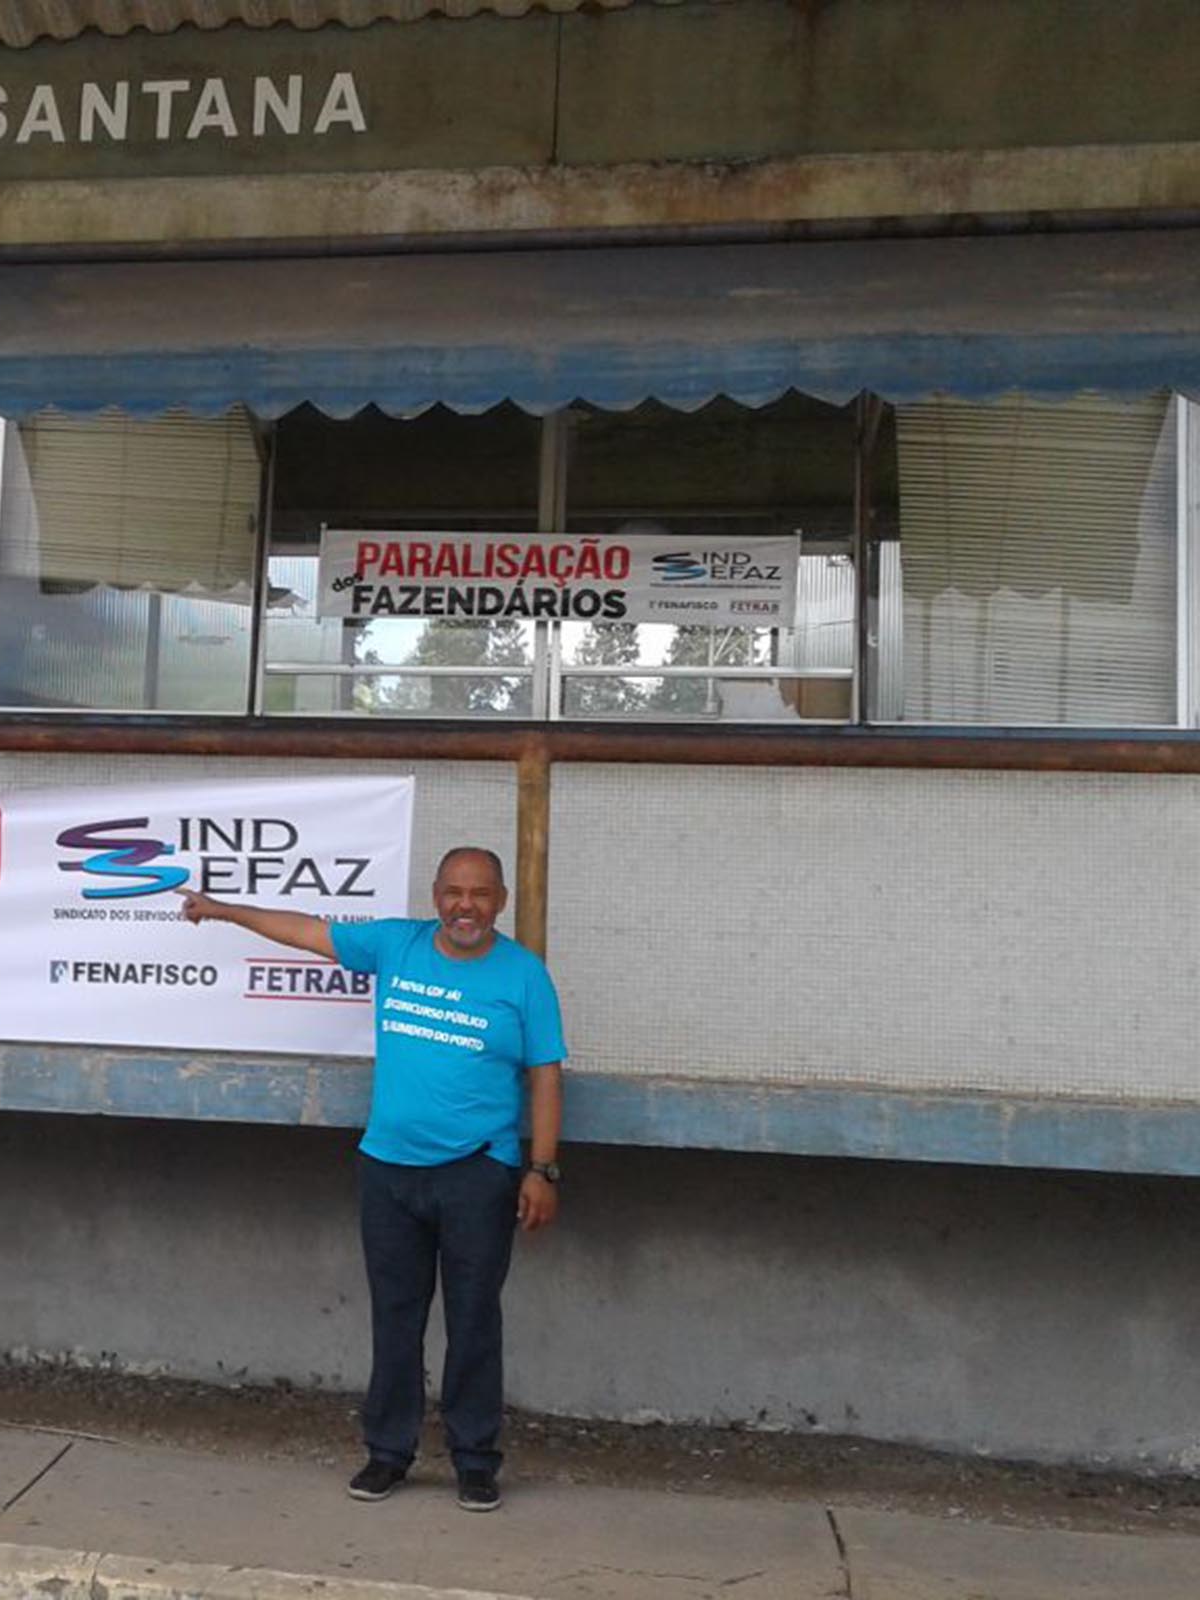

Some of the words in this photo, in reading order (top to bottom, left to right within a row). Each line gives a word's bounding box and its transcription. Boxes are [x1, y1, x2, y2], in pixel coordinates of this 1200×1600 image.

[355, 538, 630, 588] PARALISAÇÃO
[332, 572, 363, 593] dos
[352, 578, 627, 619] FAZENDÁRIOS
[54, 909, 107, 920] SINDICATO
[110, 910, 130, 921] DOS
[73, 962, 218, 986] FENAFISCO
[248, 966, 371, 995] FETRAB
